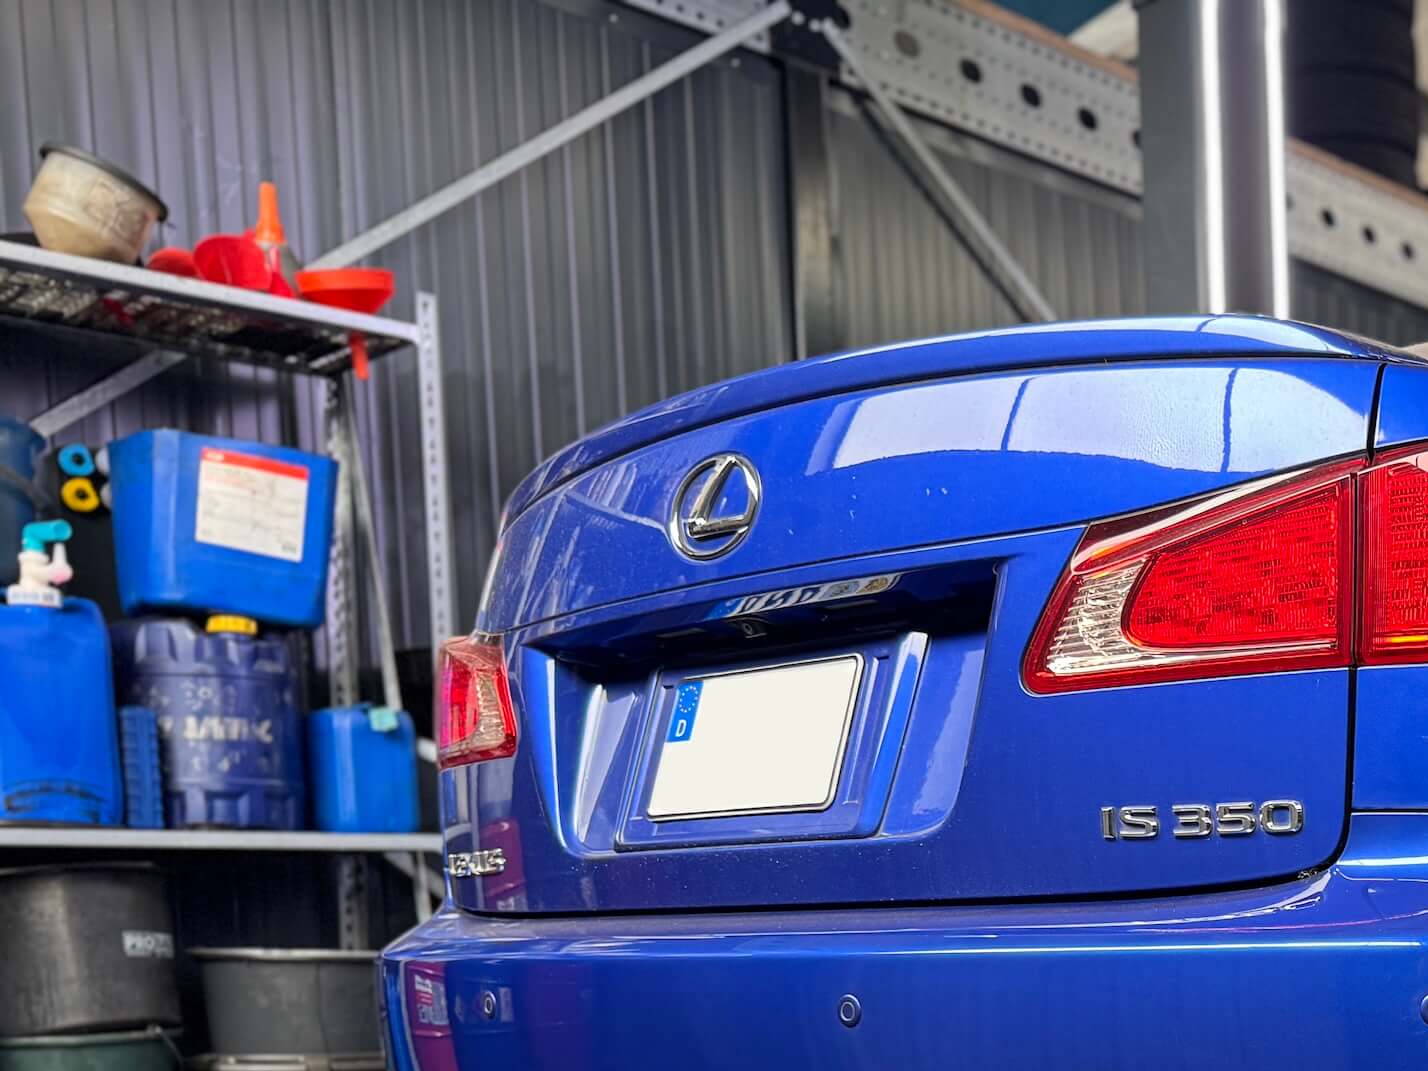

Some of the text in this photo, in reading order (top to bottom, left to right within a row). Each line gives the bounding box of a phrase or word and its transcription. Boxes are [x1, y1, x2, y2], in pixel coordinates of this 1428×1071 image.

[674, 718, 687, 738] D
[1101, 800, 1304, 841] IS 350
